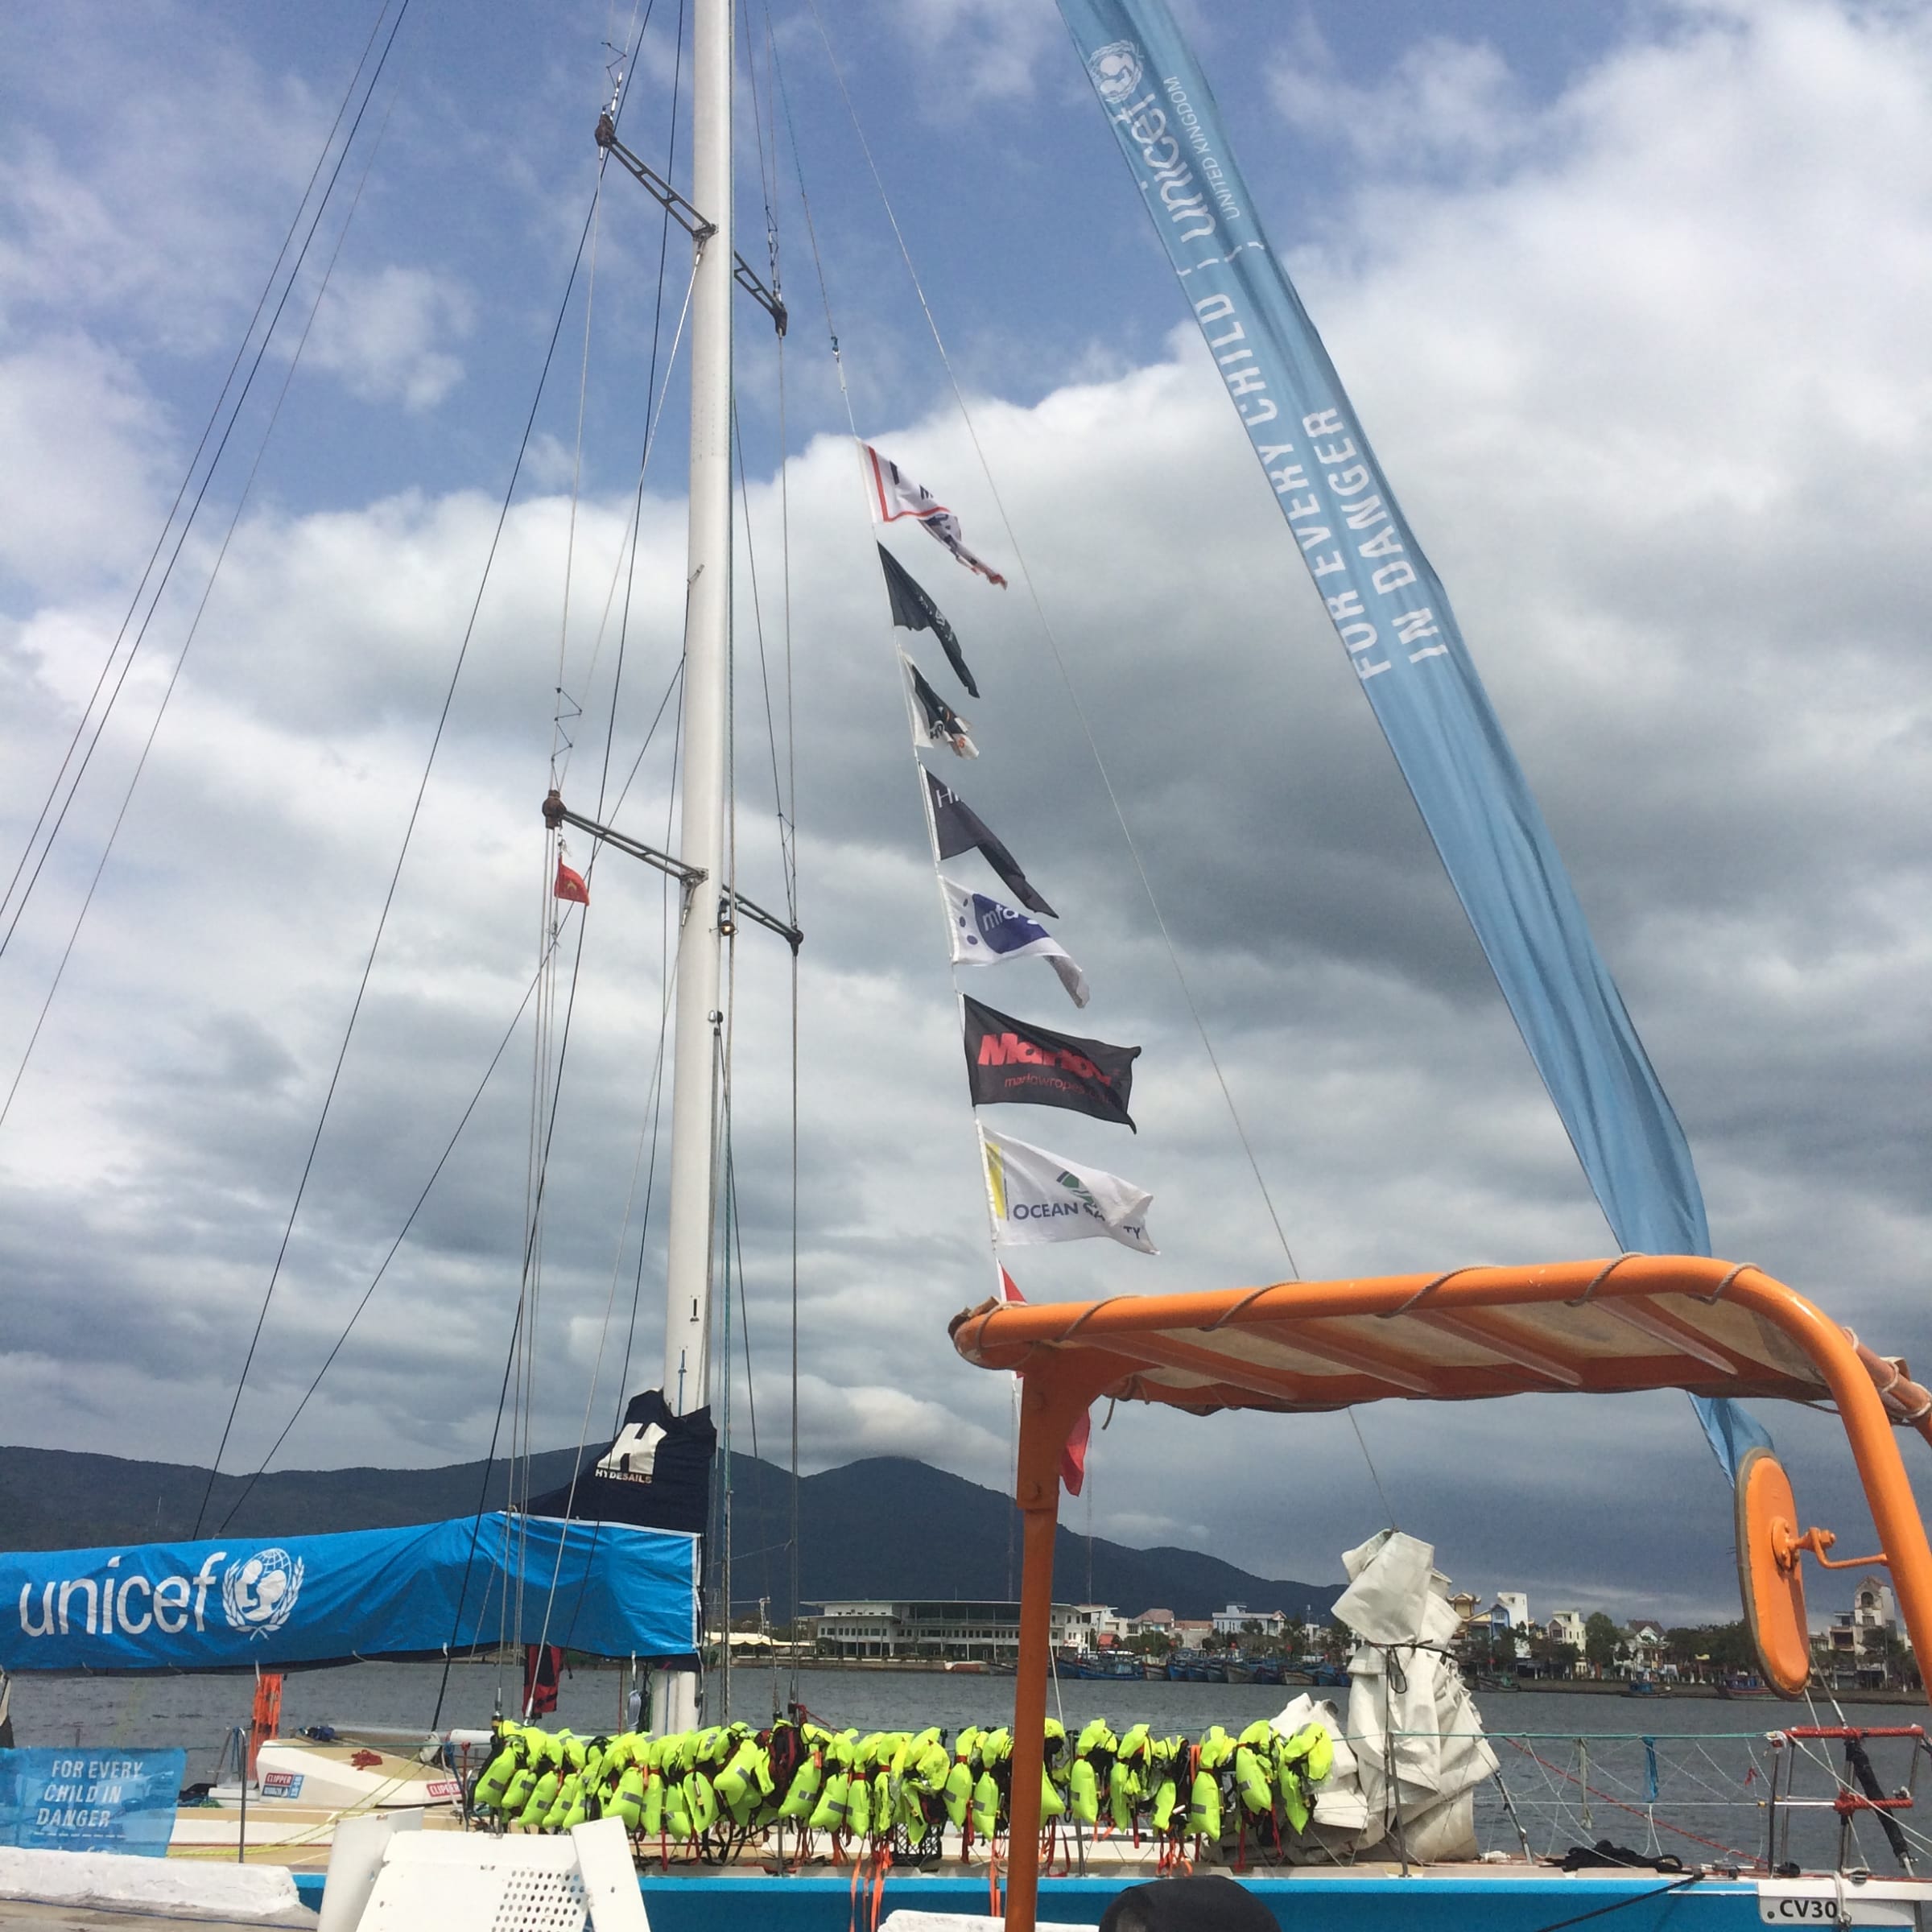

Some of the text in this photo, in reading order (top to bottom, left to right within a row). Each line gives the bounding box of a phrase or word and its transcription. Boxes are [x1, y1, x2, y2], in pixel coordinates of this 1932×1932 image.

[1163, 76, 1240, 220] UNITED KINGDOM
[1115, 93, 1216, 242] unicef
[1195, 293, 1392, 680] FOR EVERY CHILD
[1302, 407, 1449, 663] IN DANGER
[1013, 1202, 1141, 1240] OCEAN SATY
[595, 1469, 653, 1484] HYDESAILS
[19, 1551, 228, 1637] unicef
[52, 1760, 143, 1779] FOR EVERY
[266, 1773, 292, 1785] CLIPPER
[43, 1784, 122, 1803] CHILD IN
[35, 1807, 111, 1827] DANGER
[1779, 1899, 1838, 1919] CV30
